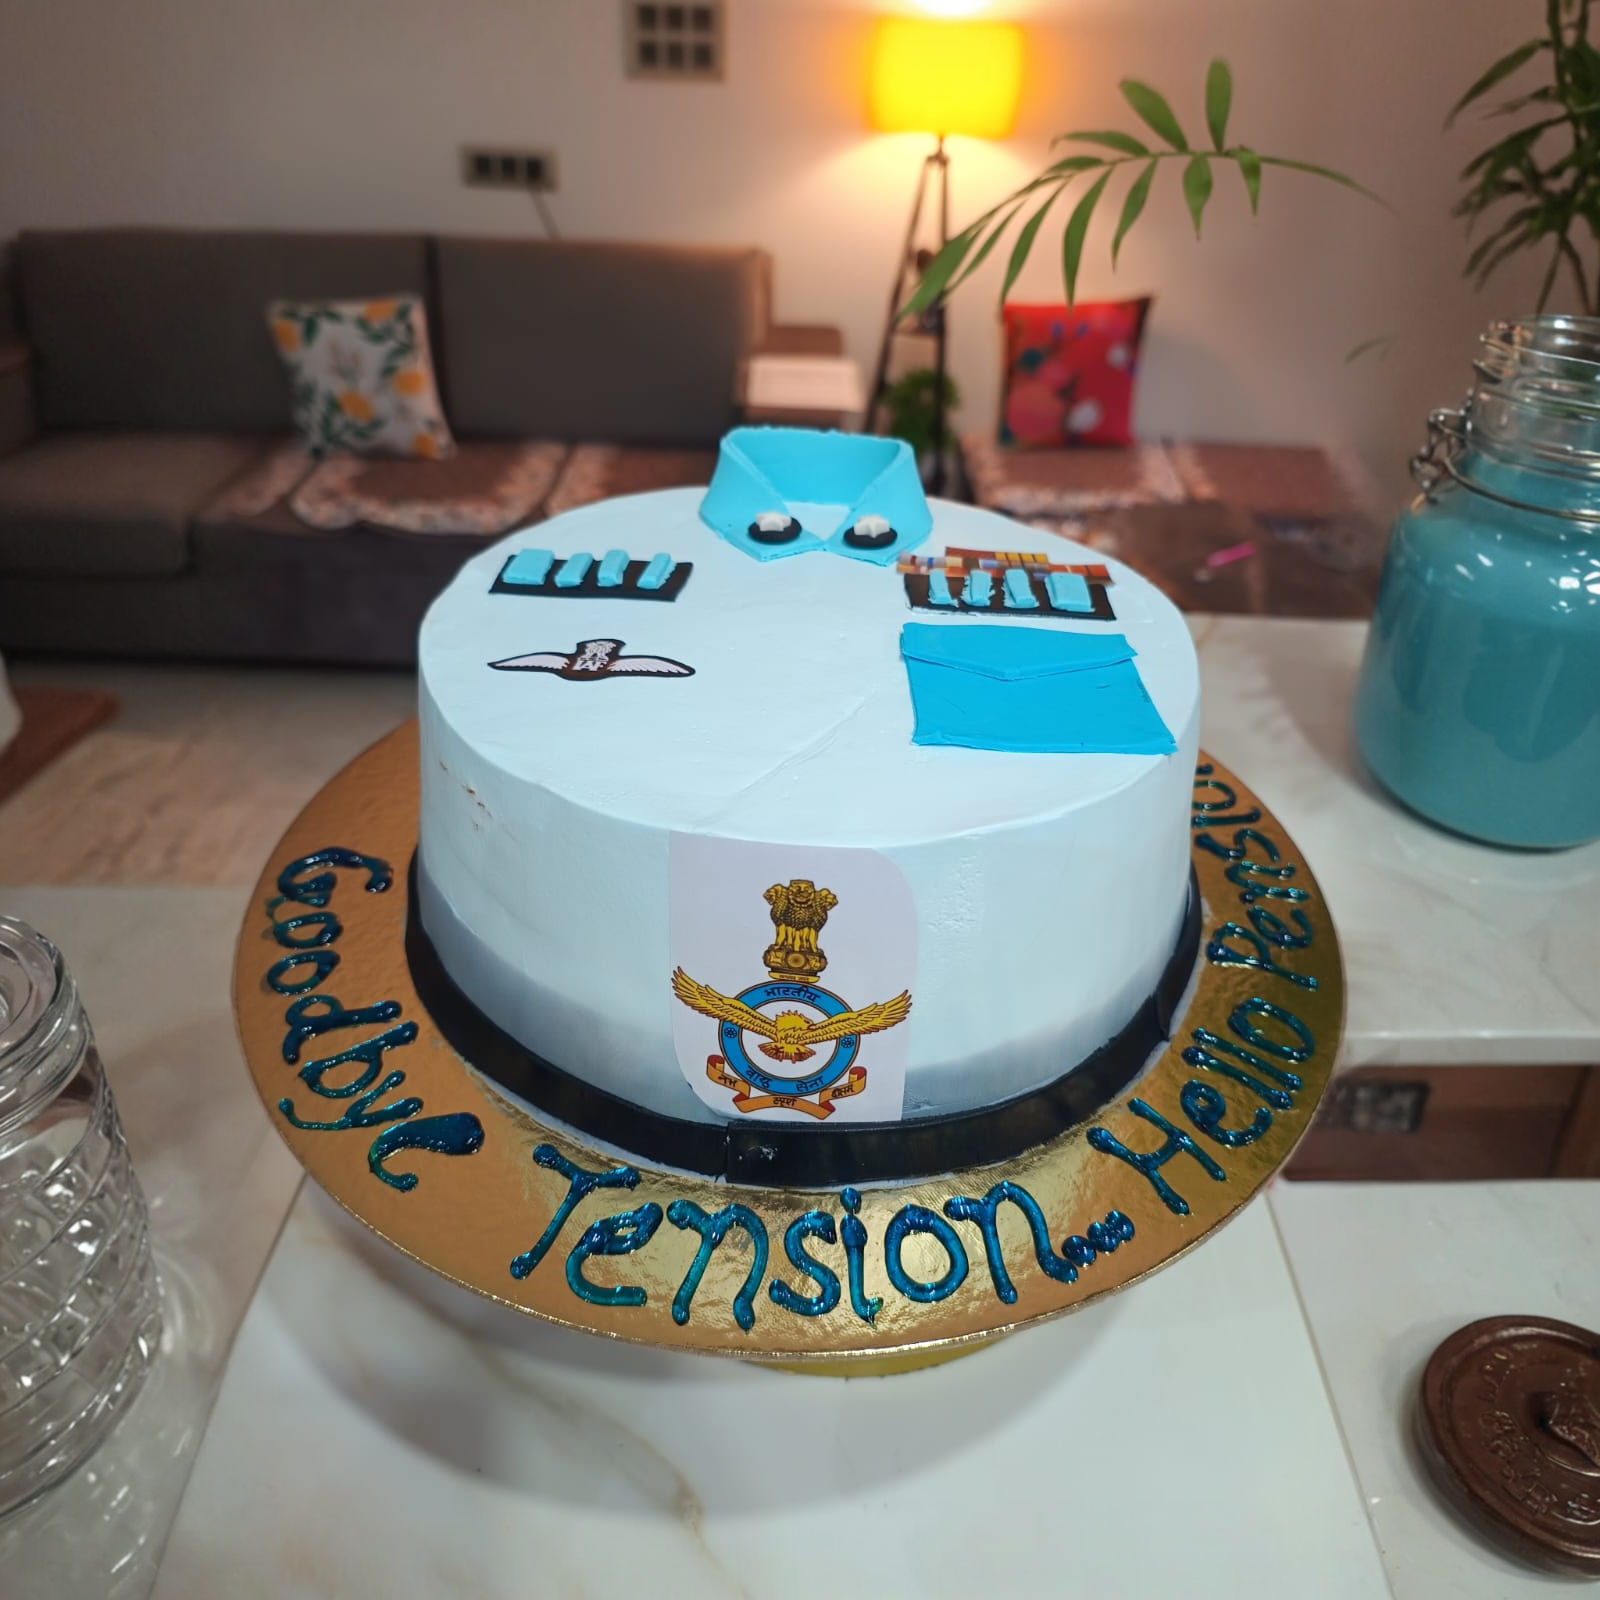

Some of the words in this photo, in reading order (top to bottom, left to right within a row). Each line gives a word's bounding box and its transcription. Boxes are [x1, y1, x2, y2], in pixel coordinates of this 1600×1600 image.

[1191, 763, 1319, 992] Pensio
[765, 985, 821, 1002] भारतीय
[1085, 997, 1315, 1217] Hello
